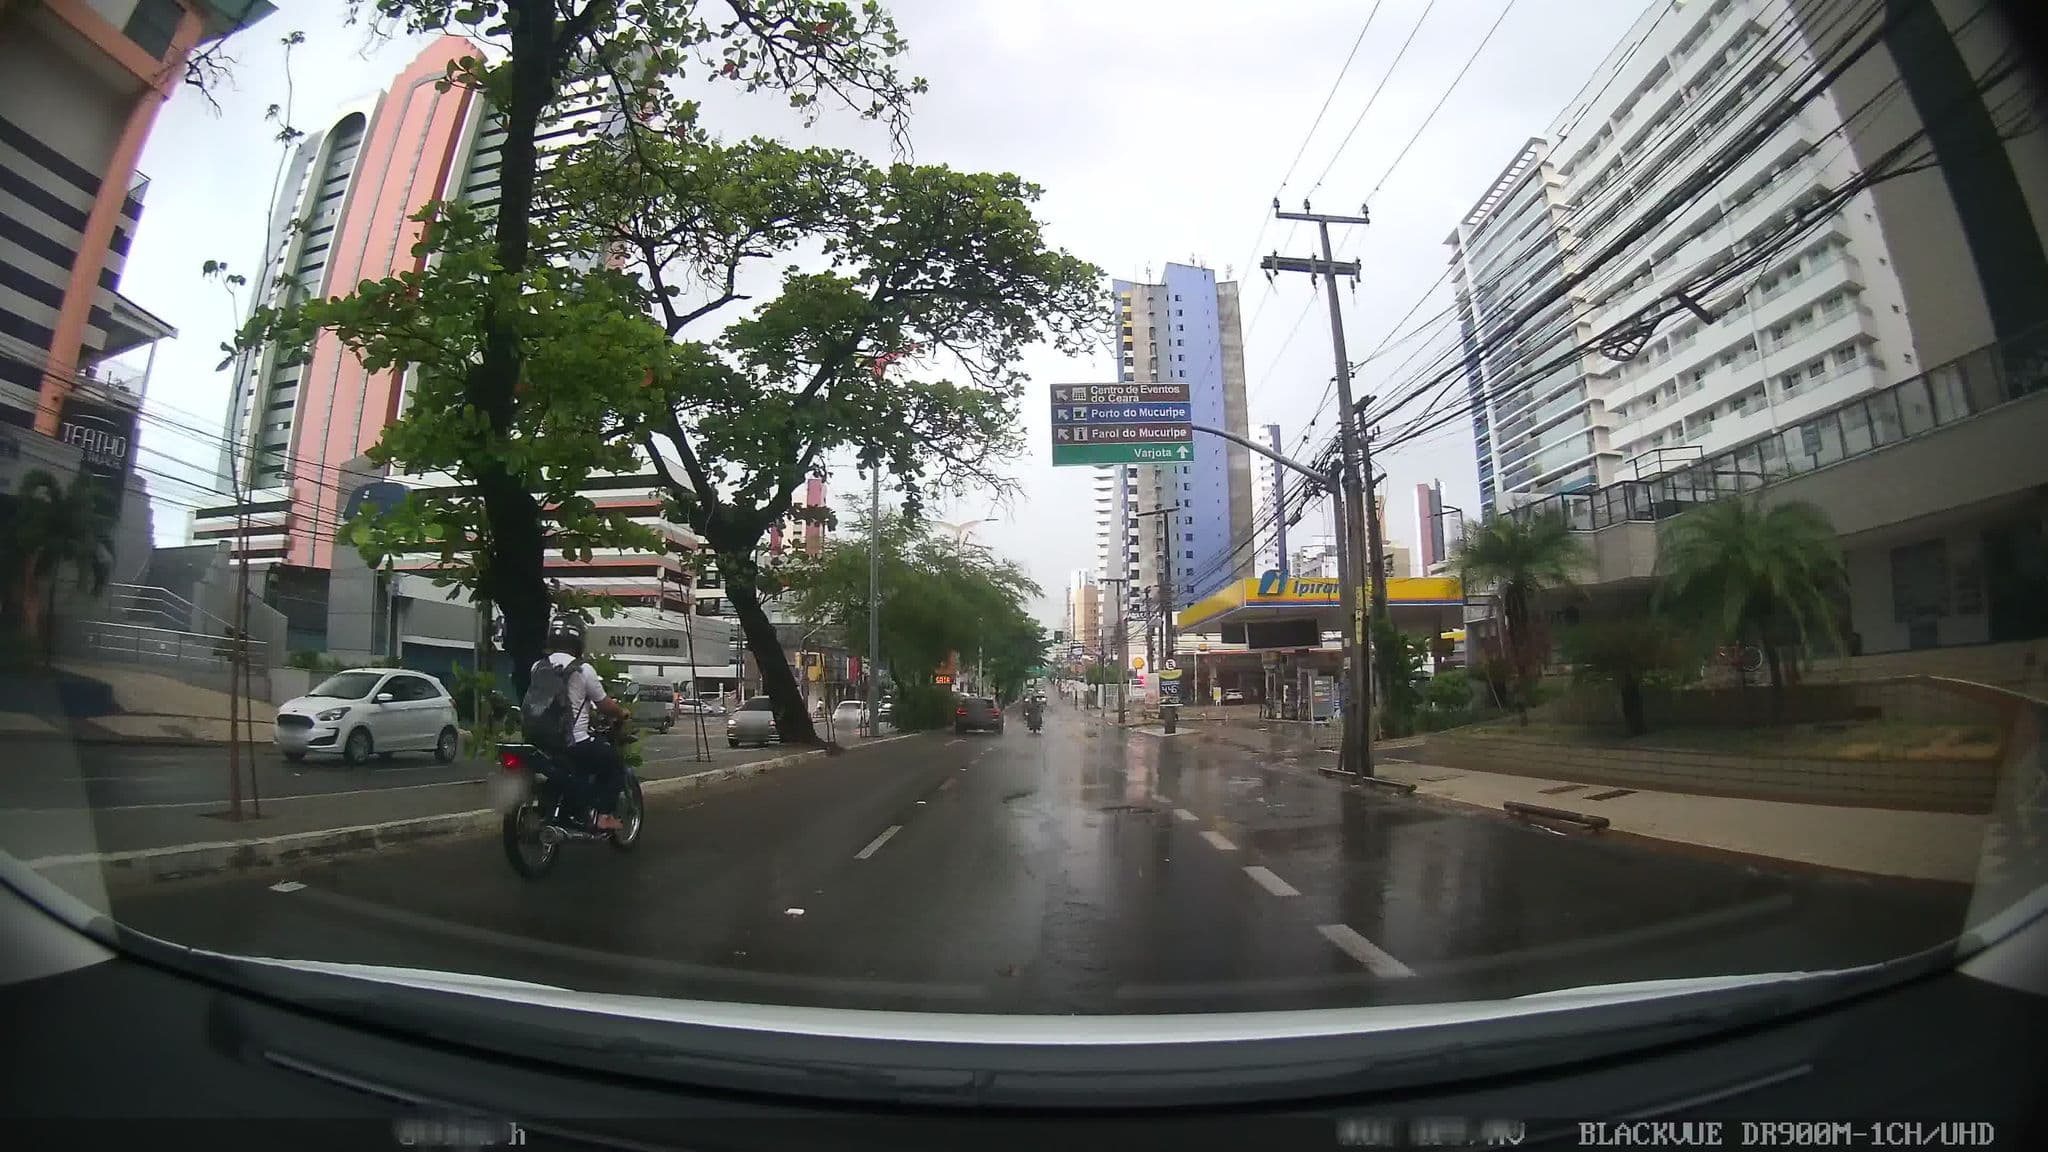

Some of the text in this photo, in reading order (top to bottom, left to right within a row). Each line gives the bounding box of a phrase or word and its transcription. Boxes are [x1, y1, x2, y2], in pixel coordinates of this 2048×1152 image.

[1090, 384, 1180, 394] Centro de Eventos
[1091, 394, 1105, 403] do
[1091, 406, 1186, 420] Porto do Mucuripe
[1091, 426, 1187, 440] Farol do Mucuripe
[1134, 449, 1172, 459] Varjota
